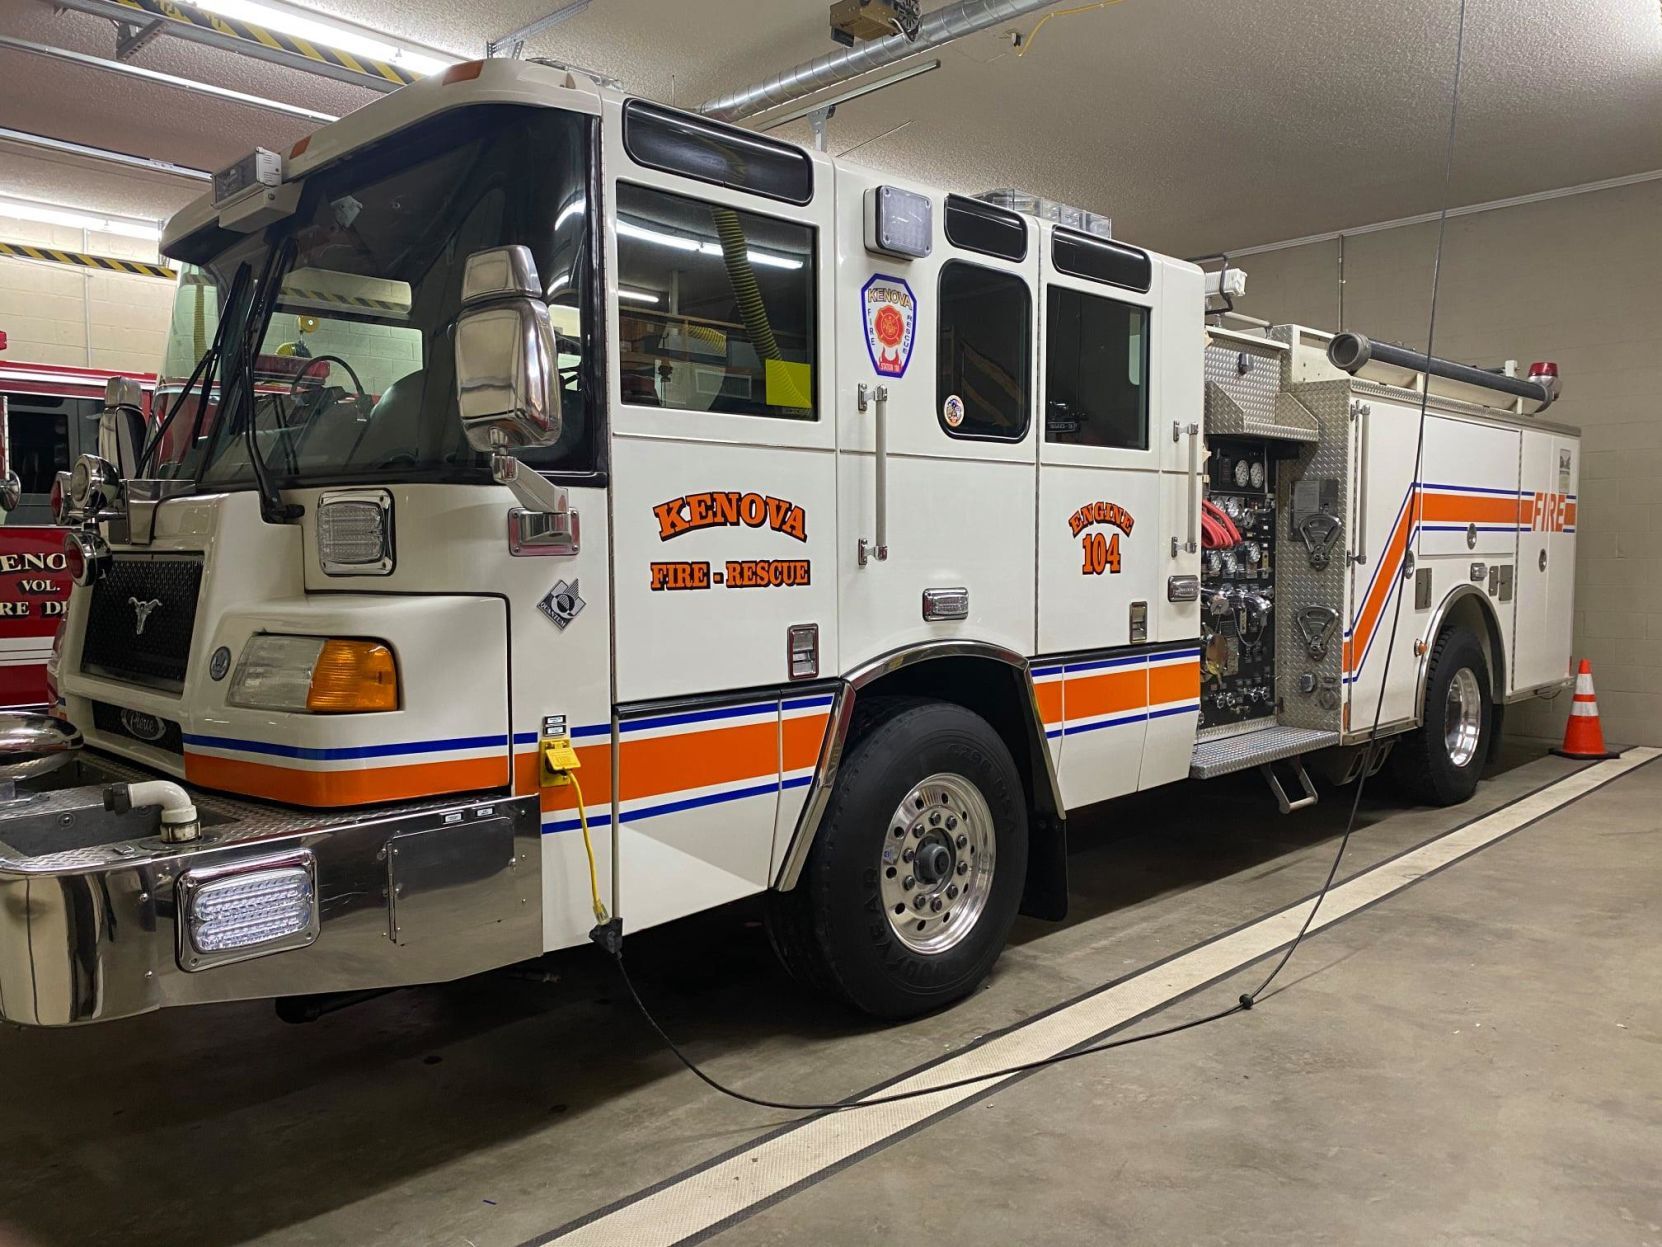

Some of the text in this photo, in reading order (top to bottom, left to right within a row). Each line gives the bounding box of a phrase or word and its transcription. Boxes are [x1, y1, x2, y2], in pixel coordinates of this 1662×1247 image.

[867, 288, 912, 310] KENOVA
[867, 308, 876, 346] FIRE
[653, 491, 808, 543] KENOVA
[1068, 501, 1135, 539] ENGINE
[1533, 491, 1566, 532] FIRE
[0, 553, 67, 573] ENO
[1082, 532, 1121, 575] 104
[21, 579, 61, 592] VOL.
[650, 561, 711, 591] FIRE
[726, 560, 811, 588] RESCUE
[0, 601, 29, 616] RE
